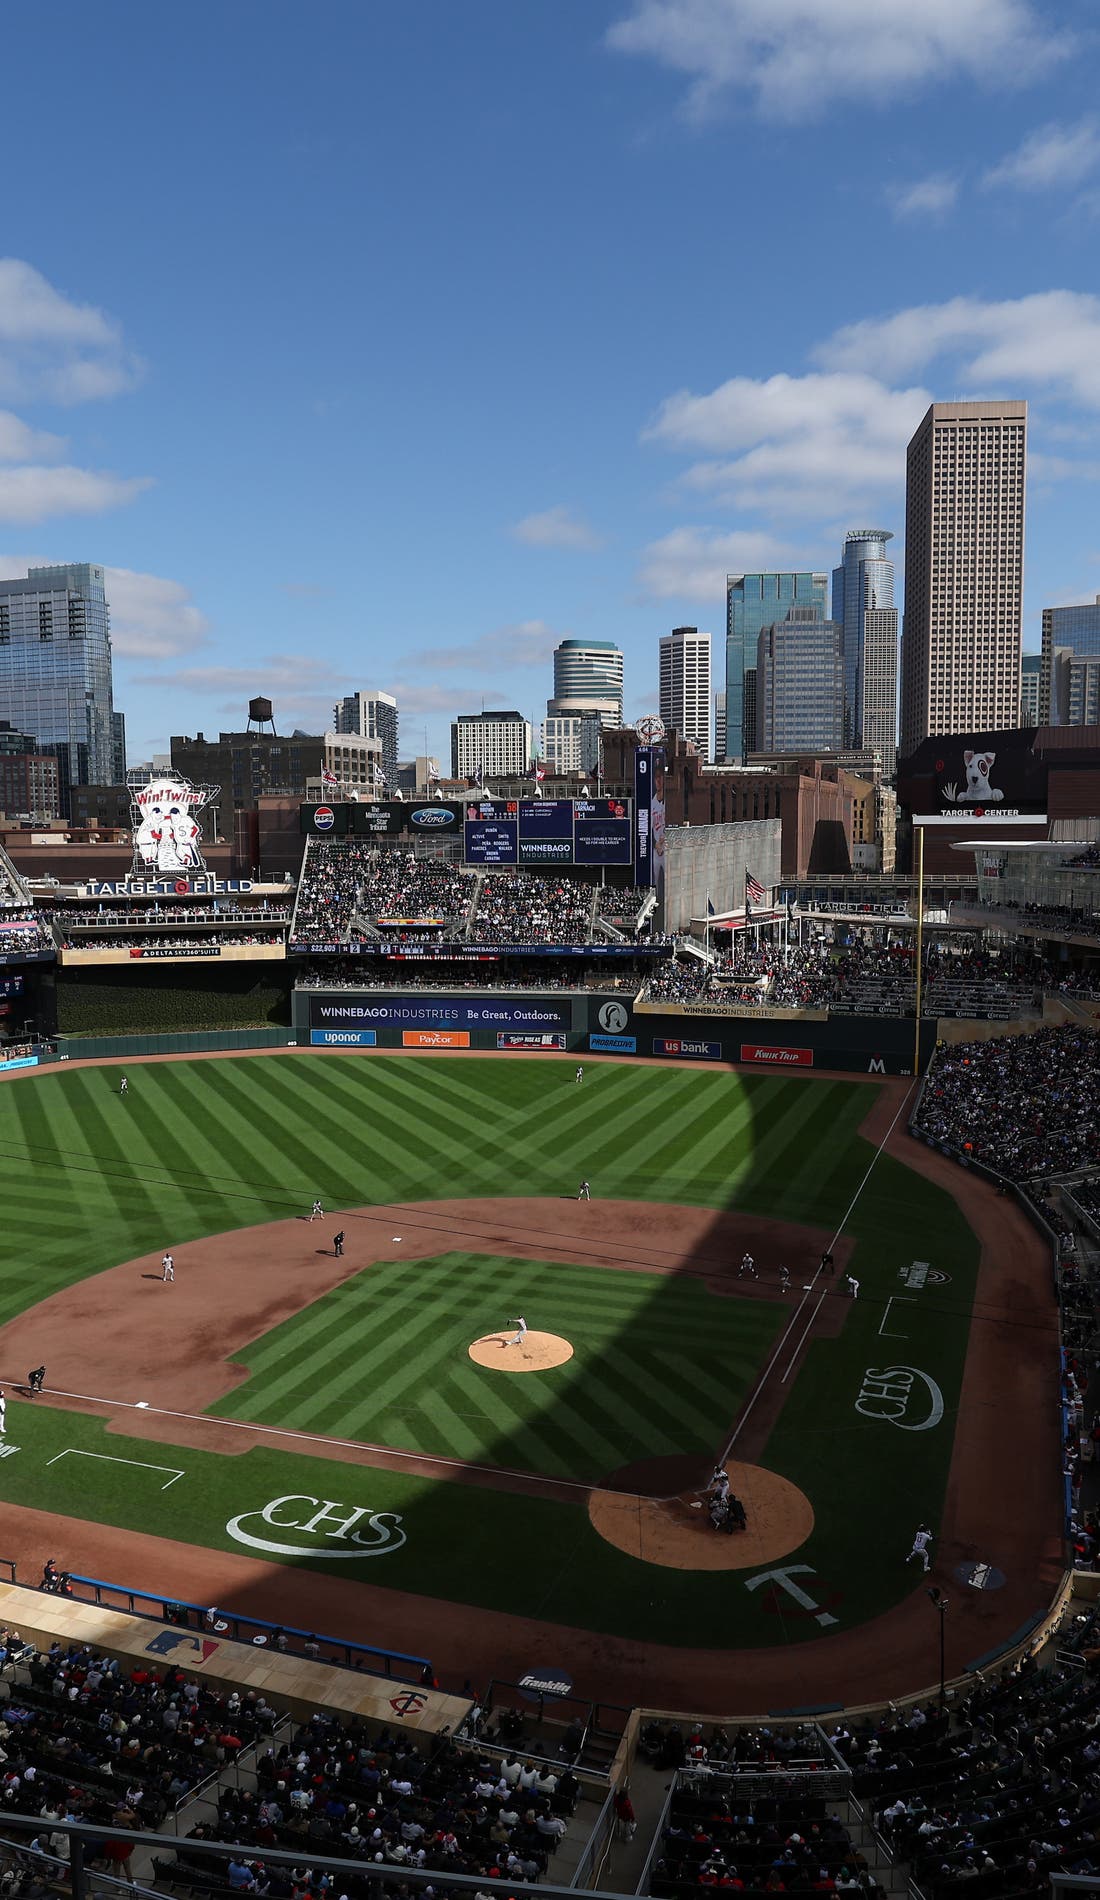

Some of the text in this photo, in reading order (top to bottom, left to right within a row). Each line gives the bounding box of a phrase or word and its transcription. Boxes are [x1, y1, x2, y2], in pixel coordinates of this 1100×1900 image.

[640, 760, 647, 773] 9
[136, 788, 205, 805] Win! Twins!
[507, 802, 517, 812] 58
[608, 801, 615, 811] 9
[419, 810, 446, 823] Ford
[638, 809, 648, 836] LARNACH
[86, 880, 253, 895] TARGET FIELD
[820, 902, 905, 912] TARGET FIELD
[320, 1007, 561, 1020] WINNEBAGO INDUSTRIES Be Great, Outdoors.
[683, 1007, 774, 1017] WINNEBAGO INDUSTRIES
[924, 1008, 1009, 1019] Corona Corona Corona
[325, 1033, 361, 1043] uponor
[420, 1035, 453, 1044] Paycor
[541, 1035, 552, 1044] ONE
[592, 1039, 633, 1048] PROGRESSIVE
[665, 1042, 709, 1054] us bank
[779, 1051, 799, 1060] TRIP
[868, 1059, 886, 1074] M
[854, 1368, 914, 1419] CHS
[262, 1495, 403, 1545] CHS
[518, 1675, 572, 1694] Franklin
